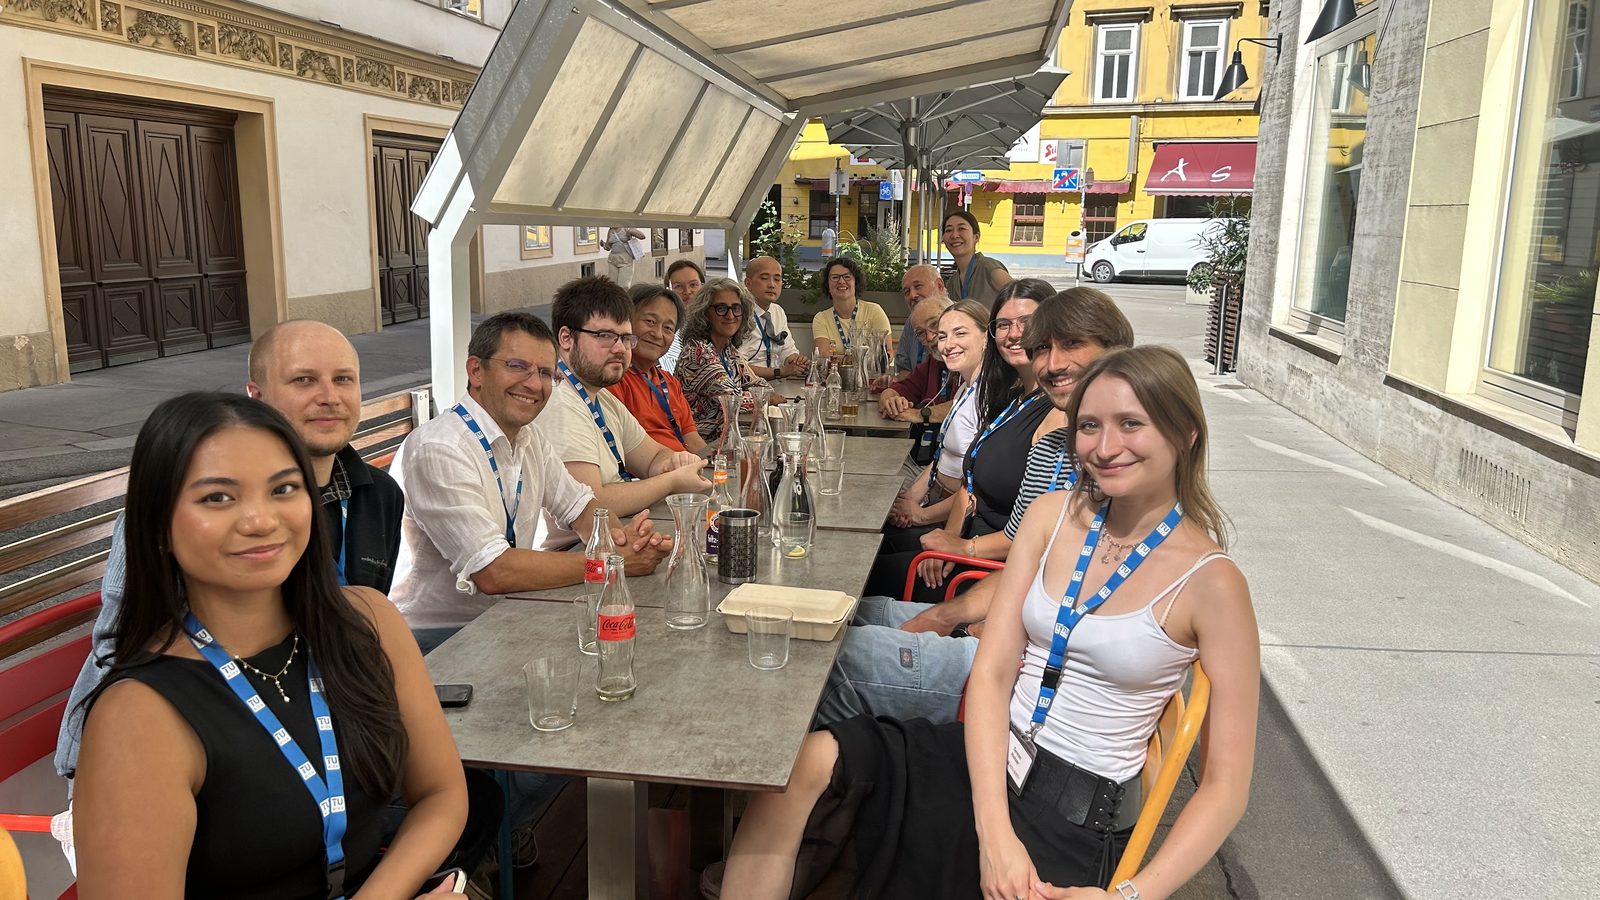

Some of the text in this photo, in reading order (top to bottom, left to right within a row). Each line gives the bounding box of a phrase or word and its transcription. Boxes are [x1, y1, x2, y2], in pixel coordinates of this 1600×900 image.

[1159, 523, 1170, 533] TU
[1139, 544, 1149, 553] TU
[1120, 565, 1130, 574] TU
[1102, 587, 1110, 595] TU
[222, 663, 235, 673] TU
[248, 697, 260, 707] TU
[274, 731, 286, 740] TU
[326, 757, 337, 765] TU
[300, 763, 311, 773] TU
[332, 799, 343, 807] TU
